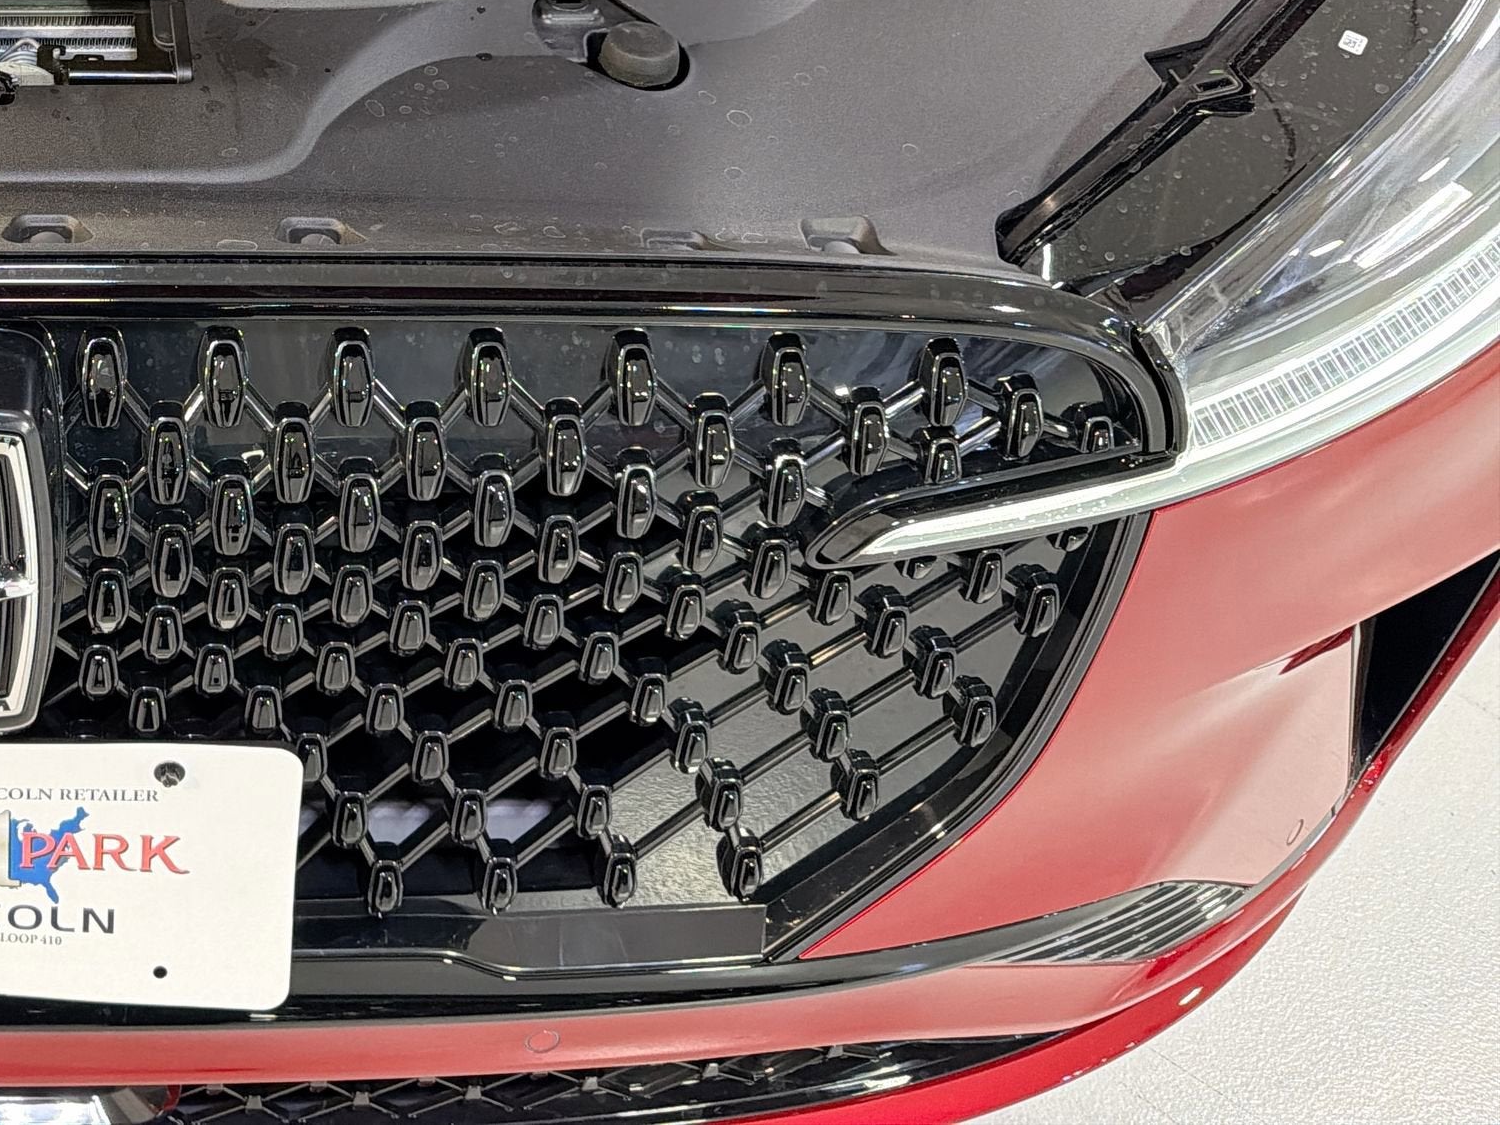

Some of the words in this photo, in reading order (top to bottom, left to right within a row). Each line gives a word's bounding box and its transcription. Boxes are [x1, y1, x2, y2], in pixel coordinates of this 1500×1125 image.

[60, 787, 159, 802] RETAILER
[19, 831, 190, 875] PARK
[0, 932, 38, 945] LOOP
[39, 935, 62, 946] 410
